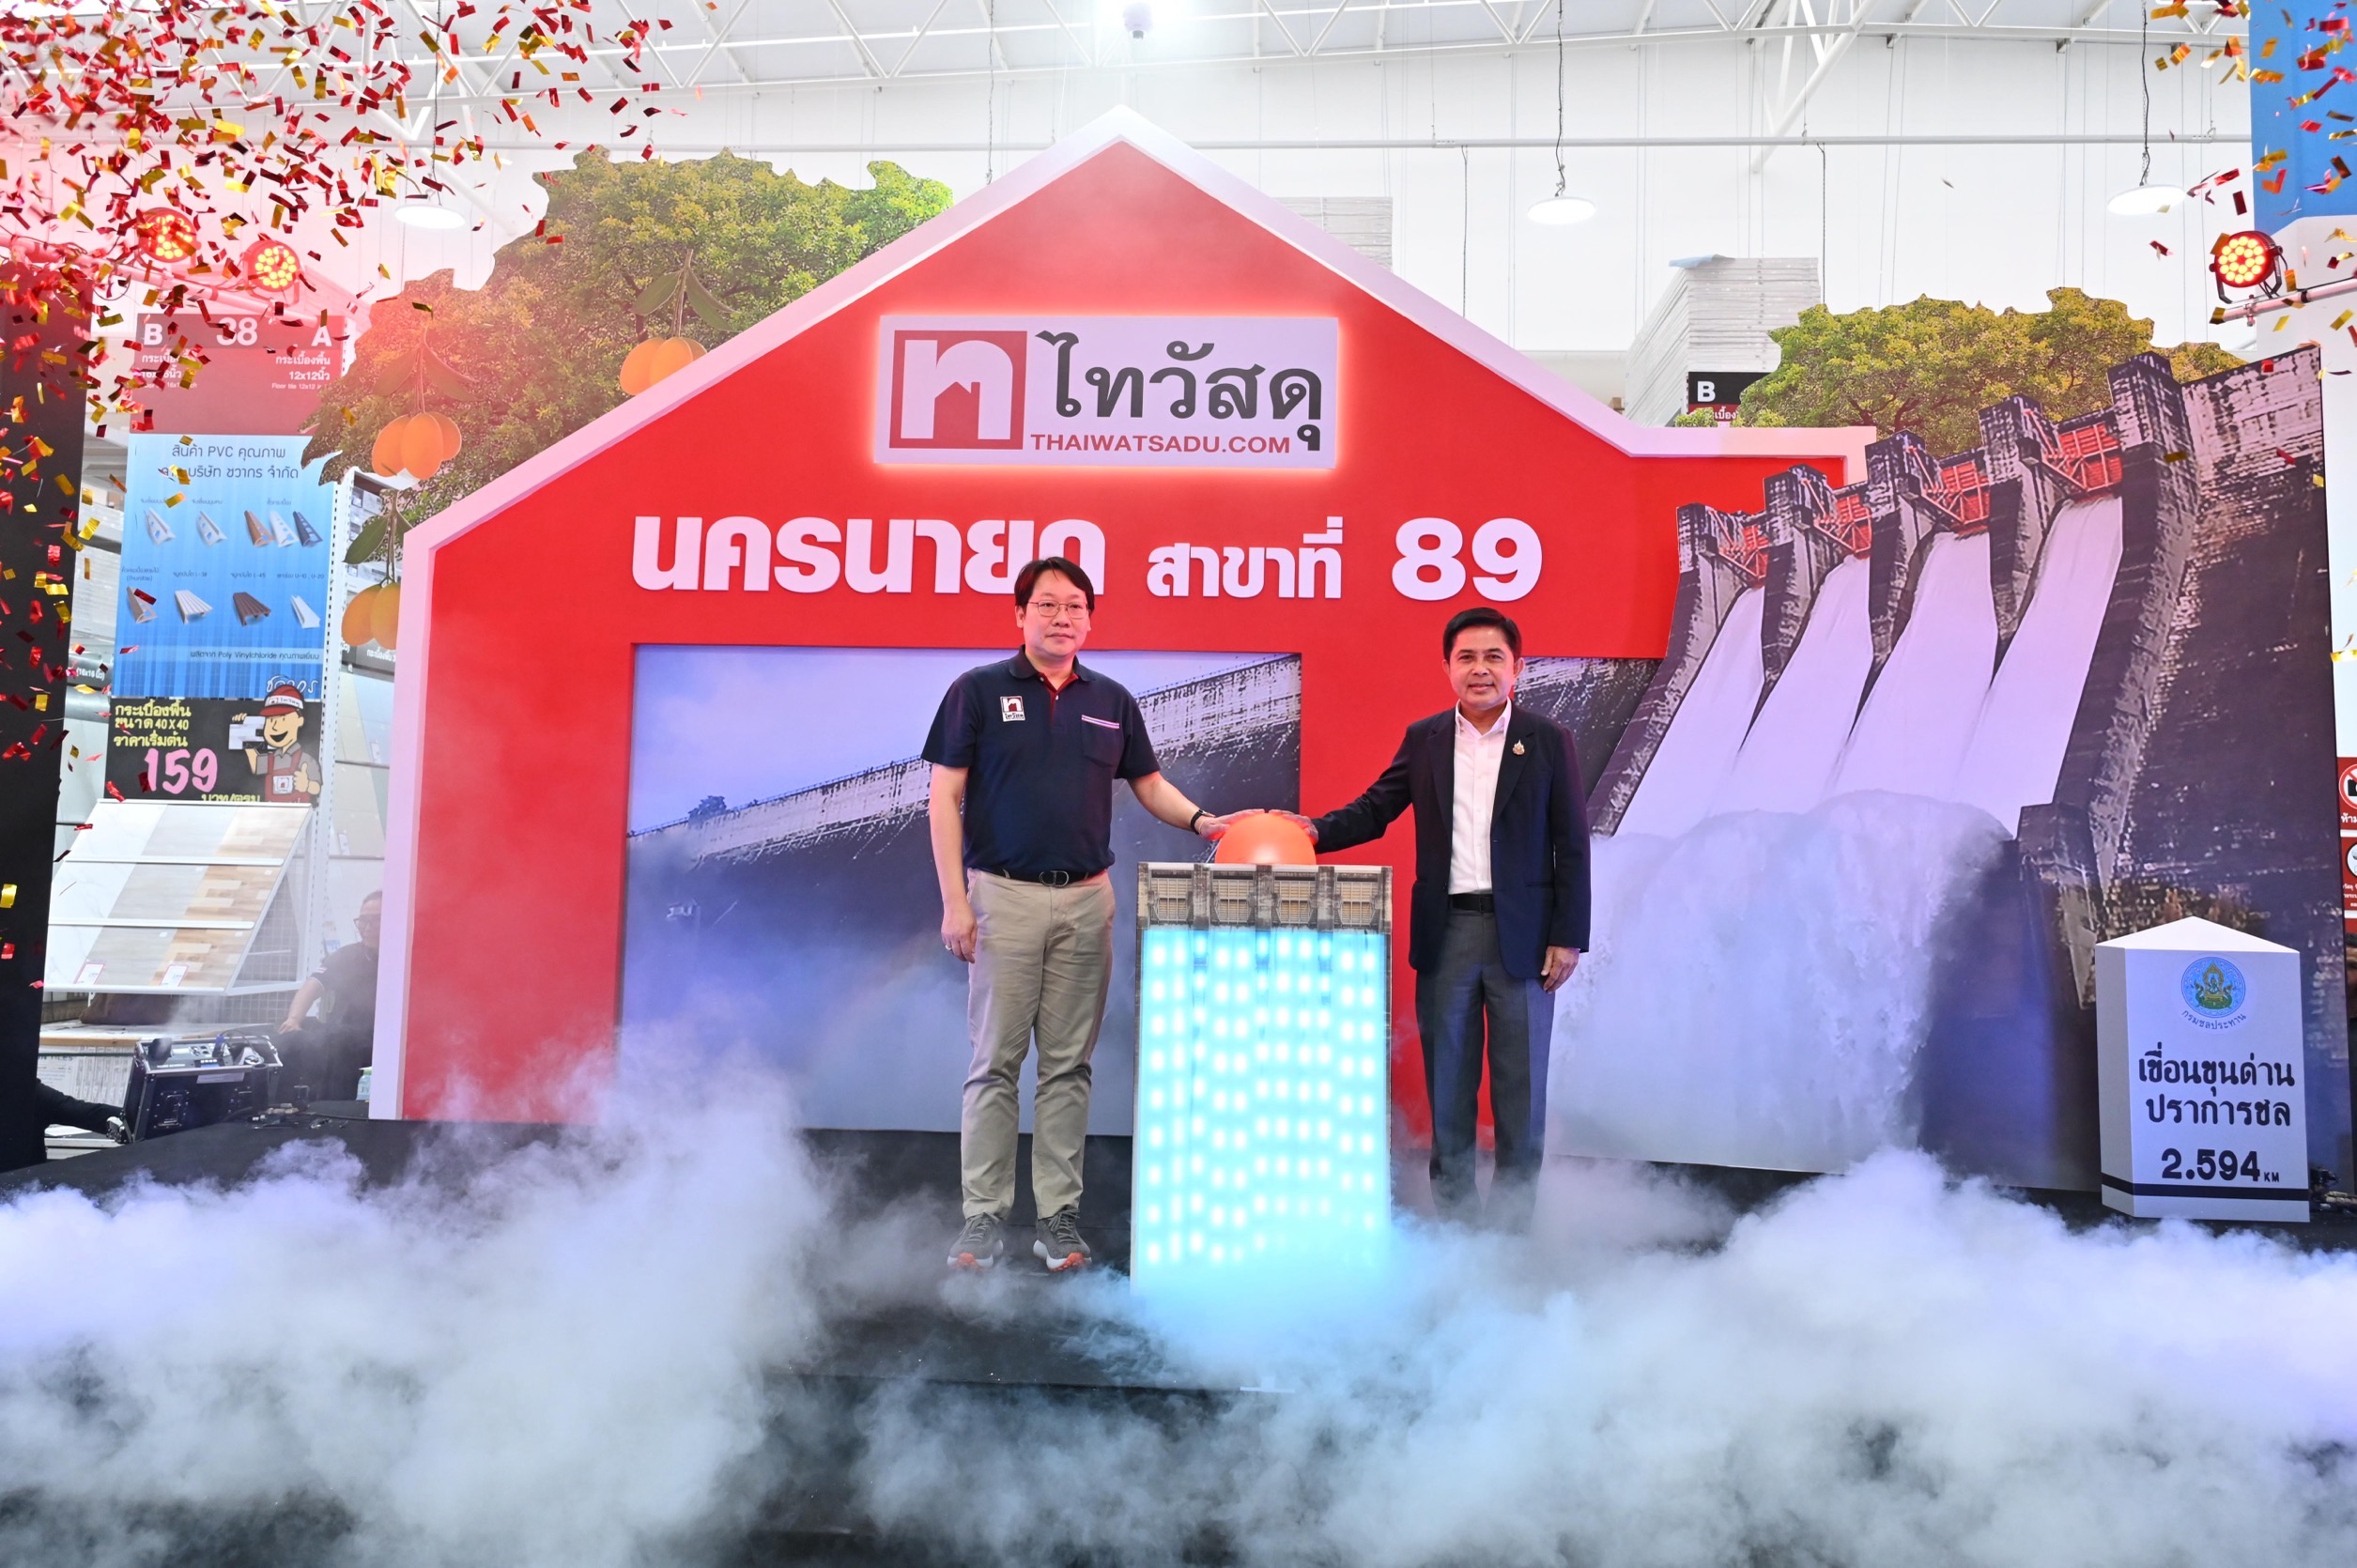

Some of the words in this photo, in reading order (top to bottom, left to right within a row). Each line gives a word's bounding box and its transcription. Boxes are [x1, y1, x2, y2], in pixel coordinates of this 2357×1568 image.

[143, 324, 163, 346] B
[312, 325, 332, 346] A
[275, 351, 331, 365] กระเบื้องพื้น
[289, 366, 331, 380] 12x12นิ้ว
[1035, 330, 1322, 452] ไทวัสดุ
[1697, 380, 1716, 403] B
[172, 444, 203, 457] สินค้า
[208, 446, 234, 458] PVC
[238, 446, 286, 461] คุณภาพ
[1030, 433, 1291, 453] THAIWATSADU.COM
[188, 465, 222, 479] บริษัท
[226, 467, 263, 479] ชวากร
[268, 466, 299, 479] จำกัด
[632, 515, 1106, 595] นครนายก
[1146, 515, 1343, 599] สาขาที่
[1392, 516, 1543, 602] 89
[218, 651, 233, 660] Poly
[115, 699, 192, 716] กระเบื้องพื้น
[155, 719, 167, 730] 40
[177, 719, 189, 730] 40
[113, 730, 189, 747] ราคาเริ่มต้น
[144, 747, 218, 794] 159
[2180, 1009, 2247, 1030] กรมชลประทาน
[2138, 1041, 2295, 1097] เขื่อนขุนด่าน
[2146, 1093, 2291, 1127] ปราการชล
[2161, 1147, 2261, 1182] 2.594
[2263, 1172, 2280, 1183] KM
